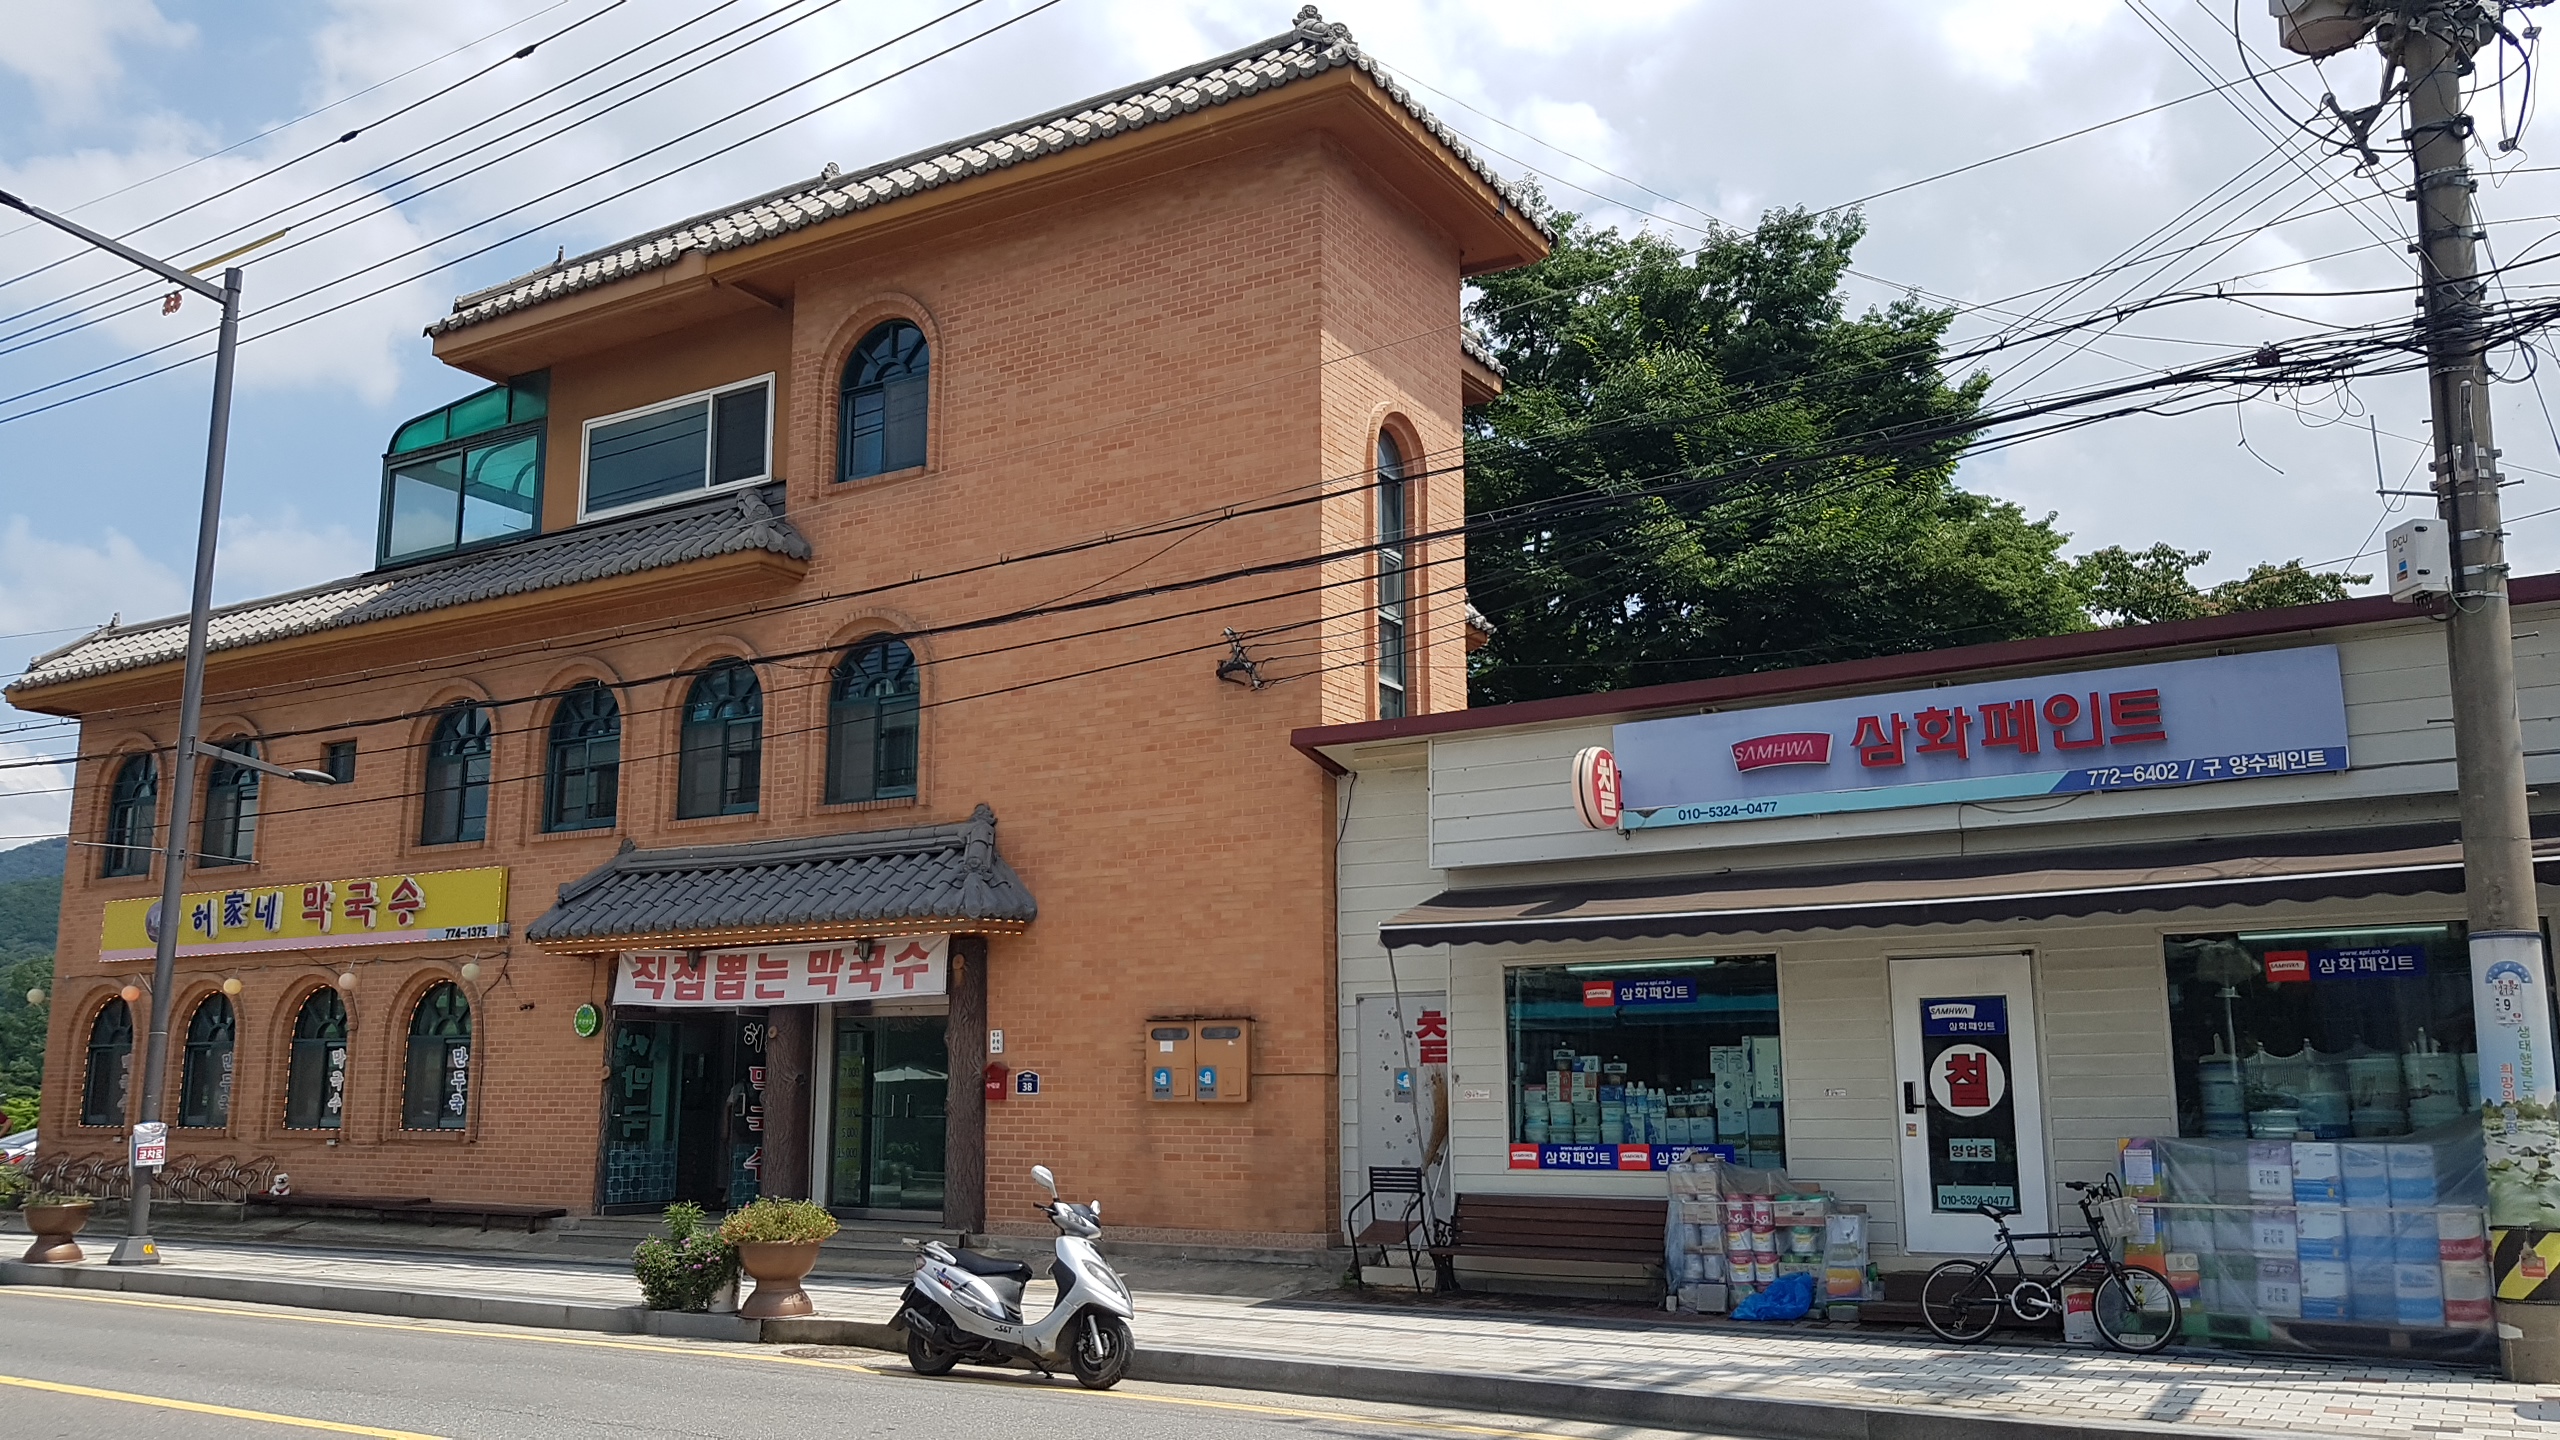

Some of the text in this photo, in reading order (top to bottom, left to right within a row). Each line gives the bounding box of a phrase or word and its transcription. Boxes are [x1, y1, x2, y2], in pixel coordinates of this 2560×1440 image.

[2392, 534, 2408, 549] DCU
[1850, 688, 2167, 768] 삼화페인트
[1736, 740, 1814, 763] SAMHWA
[2087, 763, 2179, 786] 772-6402
[2202, 758, 2222, 778] 구
[2228, 749, 2328, 775] 양수페인트
[1597, 757, 1617, 818] 칠
[1678, 801, 1778, 822] 010-5324-0477
[191, 889, 284, 940] 허家네
[445, 926, 488, 939] 774-1375
[631, 941, 930, 1001] 직접뽑는 막국수
[2318, 955, 2415, 974] 삼화페인트
[1620, 986, 1689, 1000] 삼화페인트
[1931, 1007, 1968, 1015] SAMHWA
[2503, 998, 2511, 1011] 9
[1948, 1021, 1996, 1032] 삼화페인트
[327, 1047, 346, 1114] 막국수
[448, 1046, 468, 1115] 만두국
[1022, 1082, 1033, 1092] 38
[1944, 1052, 1991, 1107] 칠
[138, 1149, 163, 1160] 교차로
[1545, 1151, 1612, 1166] 삼화페인트
[1951, 1145, 1994, 1158] 영업중
[1941, 1195, 2010, 1205] 010-5324-0477
